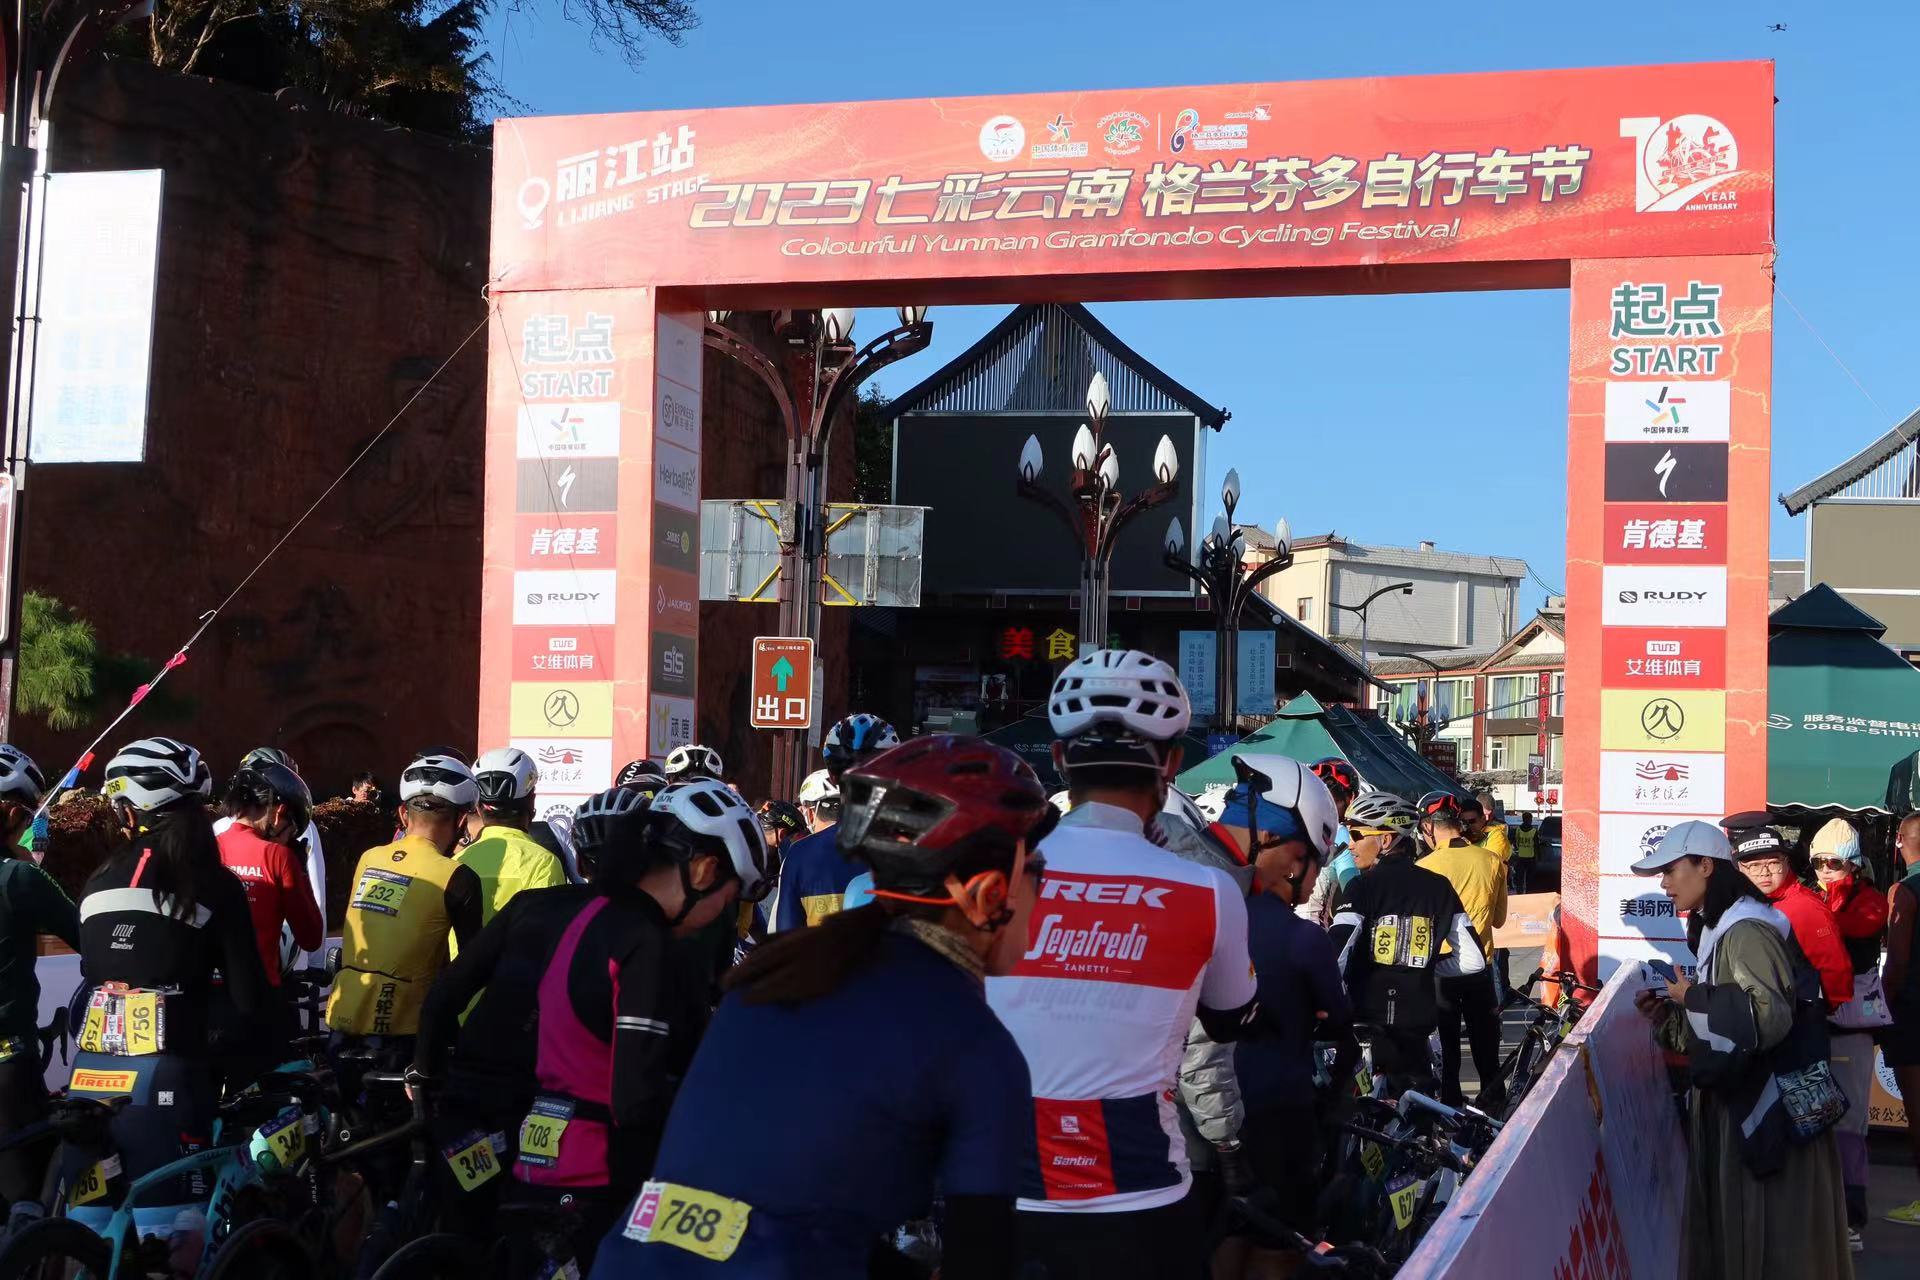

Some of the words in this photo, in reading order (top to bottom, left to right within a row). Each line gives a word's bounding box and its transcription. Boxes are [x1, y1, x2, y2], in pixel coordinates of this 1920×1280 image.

[557, 125, 696, 202] 丽江站
[1142, 145, 1591, 219] 格兰芬多自行车节
[556, 196, 634, 227] LIJIANG
[647, 174, 710, 205] STAGE
[1685, 203, 1738, 212] ANNIVERSARY
[1703, 191, 1737, 202] YEAR
[780, 235, 917, 257] Colourful
[923, 234, 1039, 255] Yunnan
[1044, 227, 1212, 250] Granfondo
[1219, 222, 1334, 249] Cycling
[1339, 217, 1461, 241] Festival
[1611, 283, 1722, 337] 起点
[525, 314, 614, 363] 起点
[1612, 347, 1721, 373] START
[524, 371, 612, 396] START
[1643, 426, 1690, 434] 中国体育彩票
[530, 528, 600, 555] 肯德基
[1623, 519, 1705, 549] 肯德基
[547, 592, 600, 601] RUDY
[1643, 591, 1707, 600] RUDY
[531, 654, 595, 670] 艾维体育
[1625, 659, 1702, 677] 艾维体育
[756, 694, 806, 721] 出口
[107, 781, 121, 794] 756
[1391, 816, 1407, 825] 436
[367, 884, 395, 902] 232
[1040, 878, 1175, 909] REK
[1620, 898, 1674, 918] 美骑网
[1024, 914, 1149, 962] Segafredo
[1377, 930, 1391, 955] 436
[1414, 926, 1428, 951] 436
[1064, 963, 1110, 974] ZANETTI
[85, 1017, 101, 1052] 756
[132, 1006, 150, 1045] 756
[74, 1072, 129, 1088] PIRELLI
[527, 1123, 552, 1148] 708
[1052, 1155, 1097, 1167] Santini
[636, 1199, 657, 1221] F
[660, 1199, 723, 1243] 768
